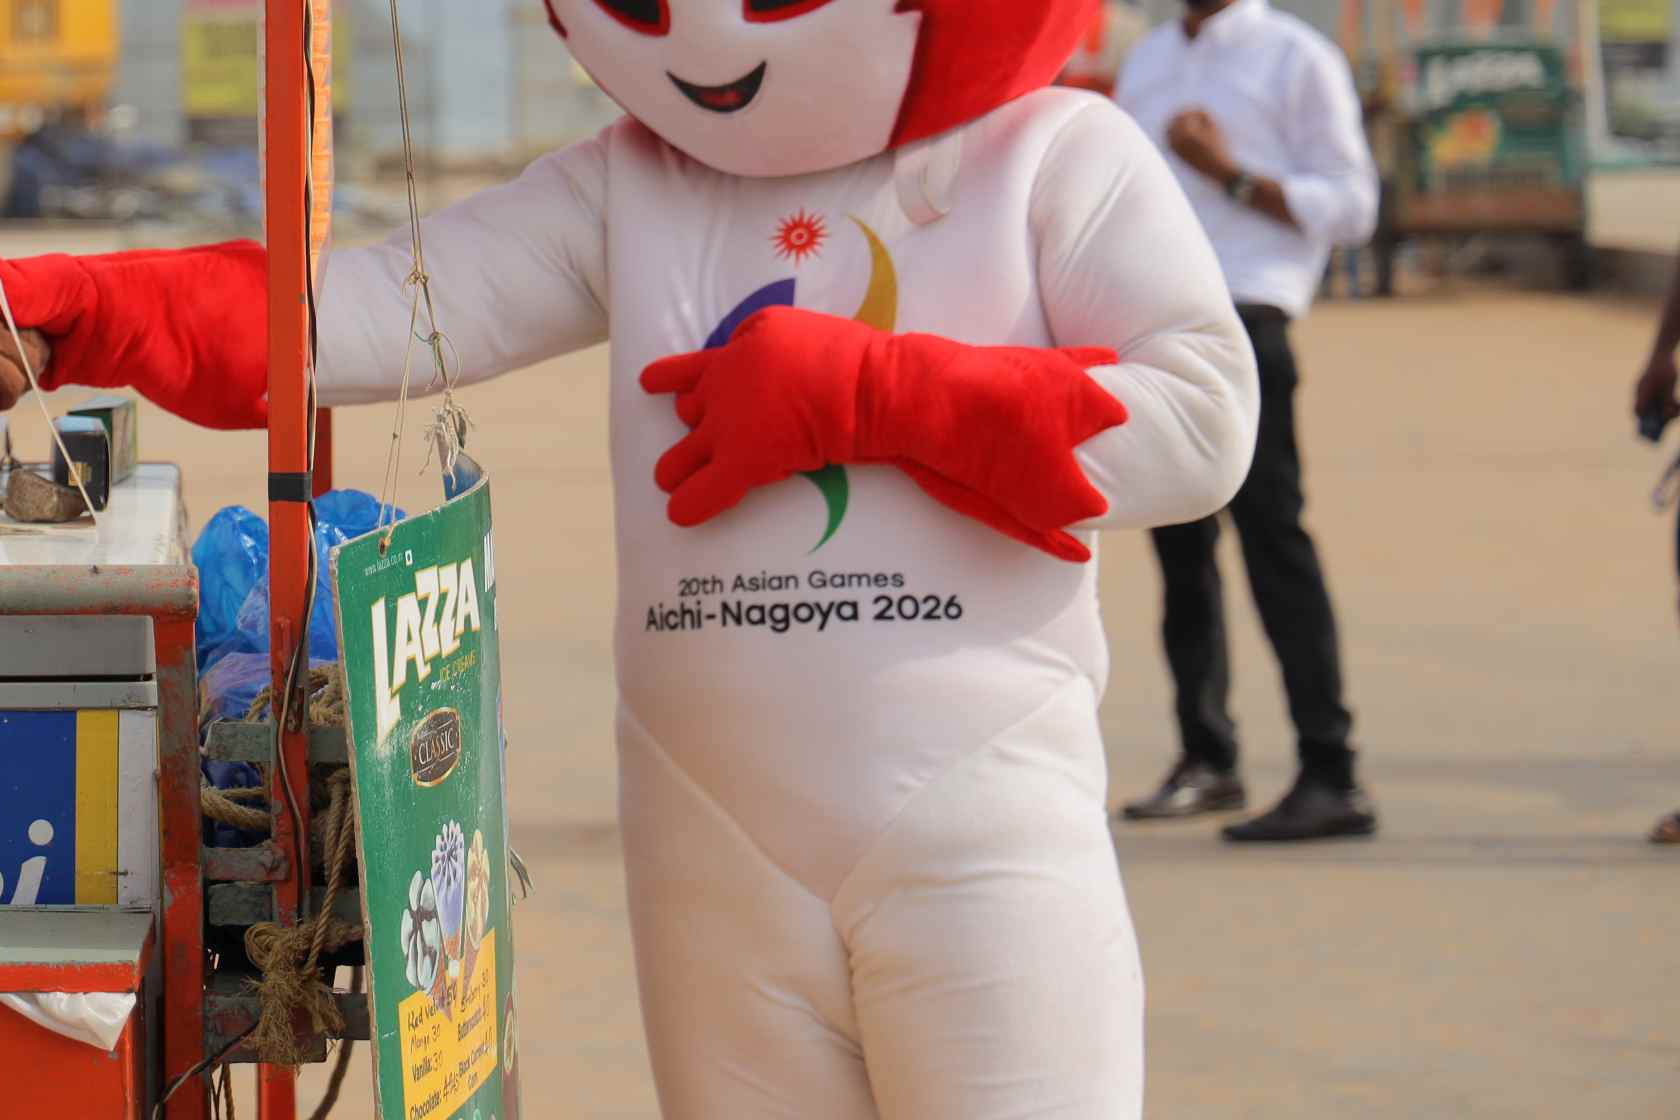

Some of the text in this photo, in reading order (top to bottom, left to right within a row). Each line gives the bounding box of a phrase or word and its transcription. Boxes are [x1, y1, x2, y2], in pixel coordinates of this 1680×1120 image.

[679, 570, 905, 597] 20th Asian Games
[645, 595, 963, 633] Aichi-Nagoya 2026
[371, 557, 482, 750] LAZZA
[418, 728, 455, 765] CLASSIC
